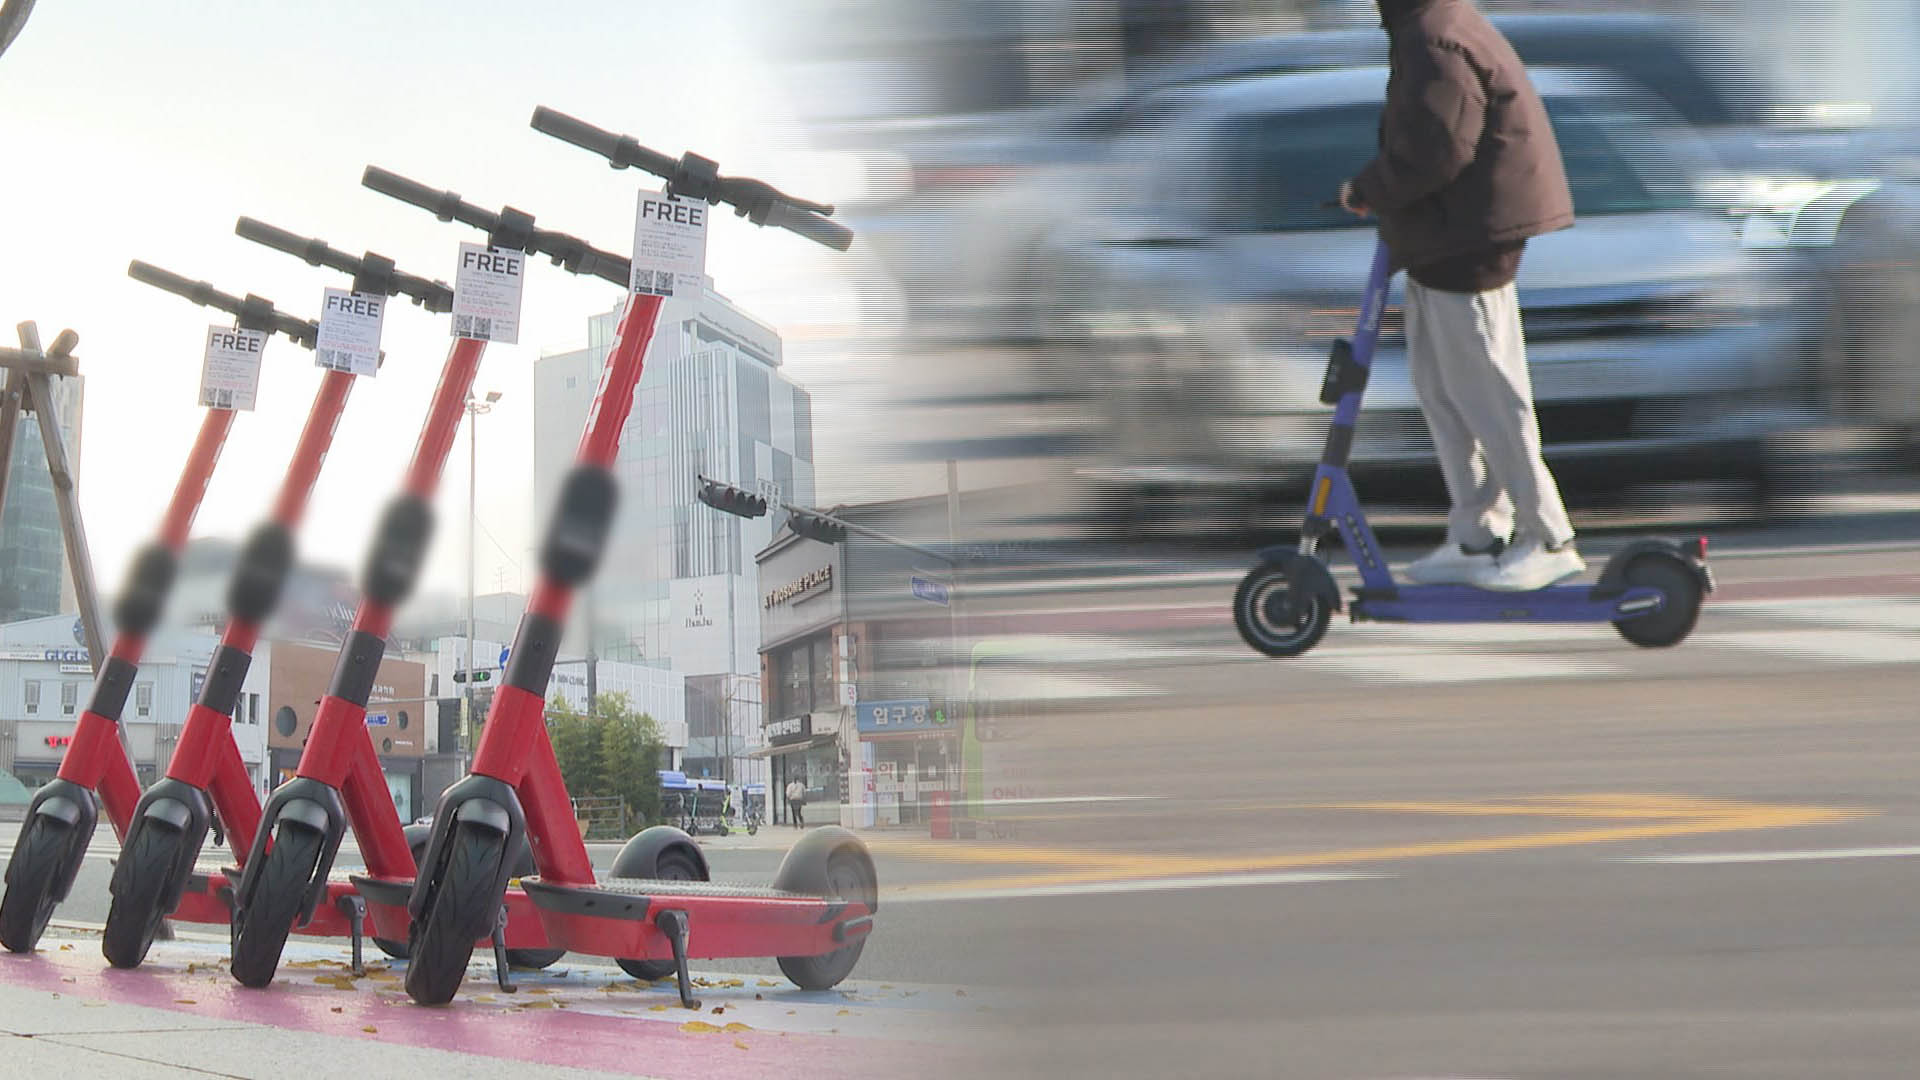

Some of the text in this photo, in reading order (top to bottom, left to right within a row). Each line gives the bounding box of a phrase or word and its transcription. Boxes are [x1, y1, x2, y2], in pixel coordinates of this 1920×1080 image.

[642, 199, 703, 227] FREE
[463, 251, 520, 276] FREE
[327, 295, 380, 318] FREE
[211, 333, 260, 353] FREE
[803, 565, 831, 589] PLACE
[872, 704, 927, 725] 압구정
